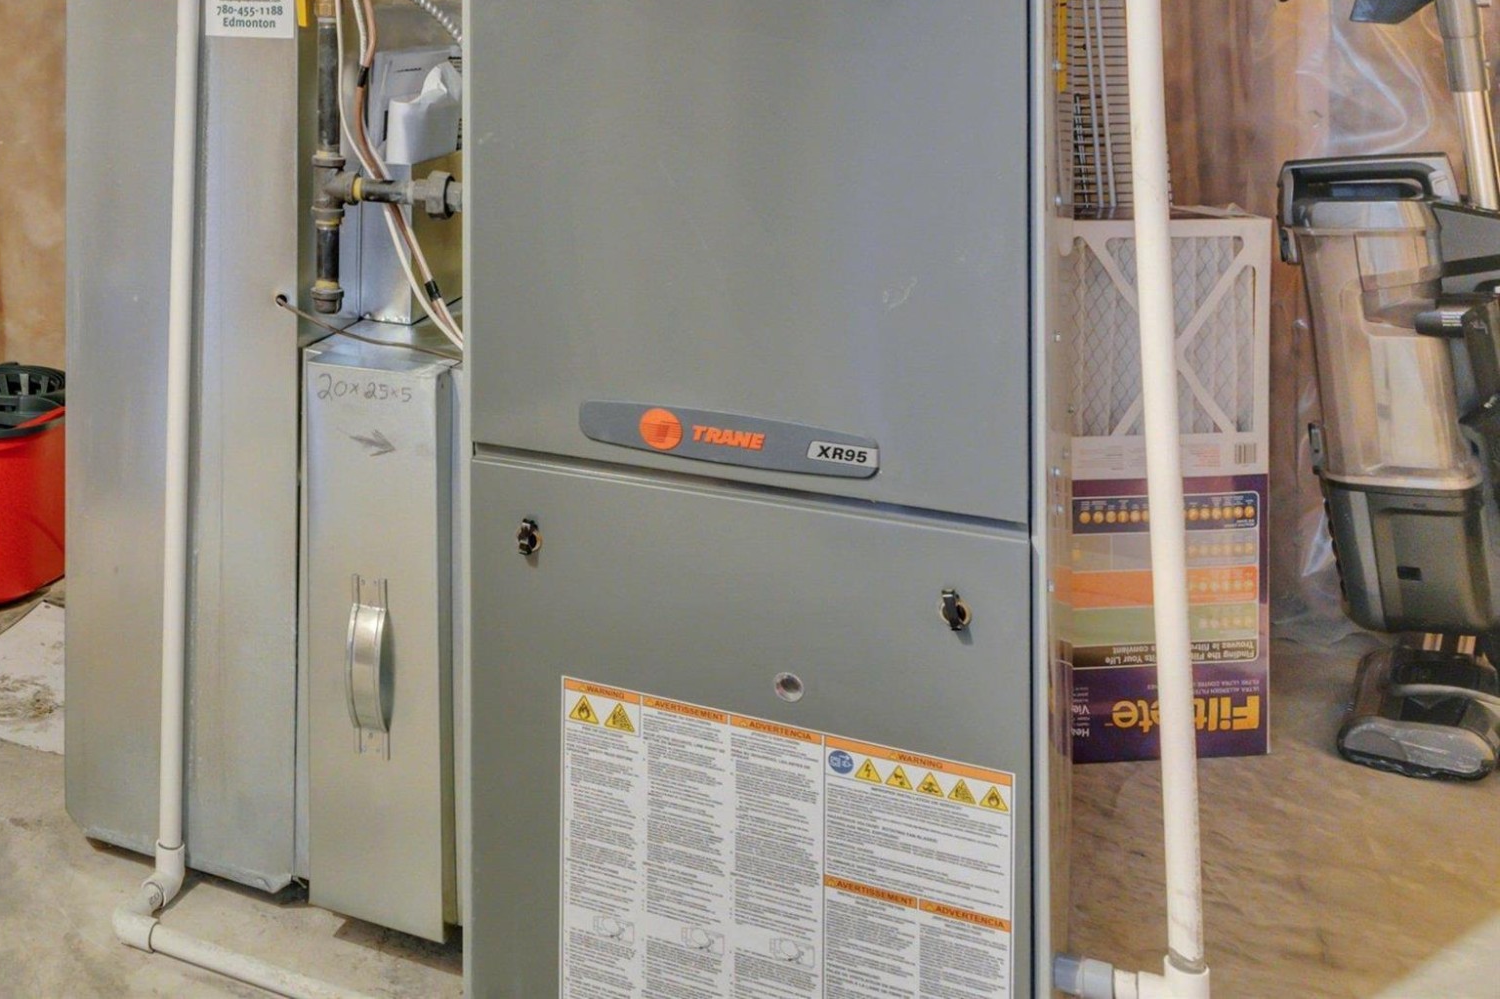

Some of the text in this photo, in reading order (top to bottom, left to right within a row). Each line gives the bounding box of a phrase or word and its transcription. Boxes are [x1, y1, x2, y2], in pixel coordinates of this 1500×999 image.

[216, 5, 284, 18] 780-455-1188
[222, 17, 277, 29] Edmonton
[691, 424, 766, 450] TRANE
[817, 444, 869, 464] XR95
[1112, 645, 1149, 656] convient
[1221, 641, 1255, 651] Trouvez
[1104, 649, 1255, 666] Finding the Your Life
[585, 684, 625, 700] WARNING
[654, 700, 724, 721] AVERTISSEMENT
[749, 720, 812, 741] ADVERTENCIA
[897, 753, 944, 770] WARNING
[836, 879, 914, 906] AVERTISSEMENT
[935, 904, 1006, 930] ADVERTENCIA
